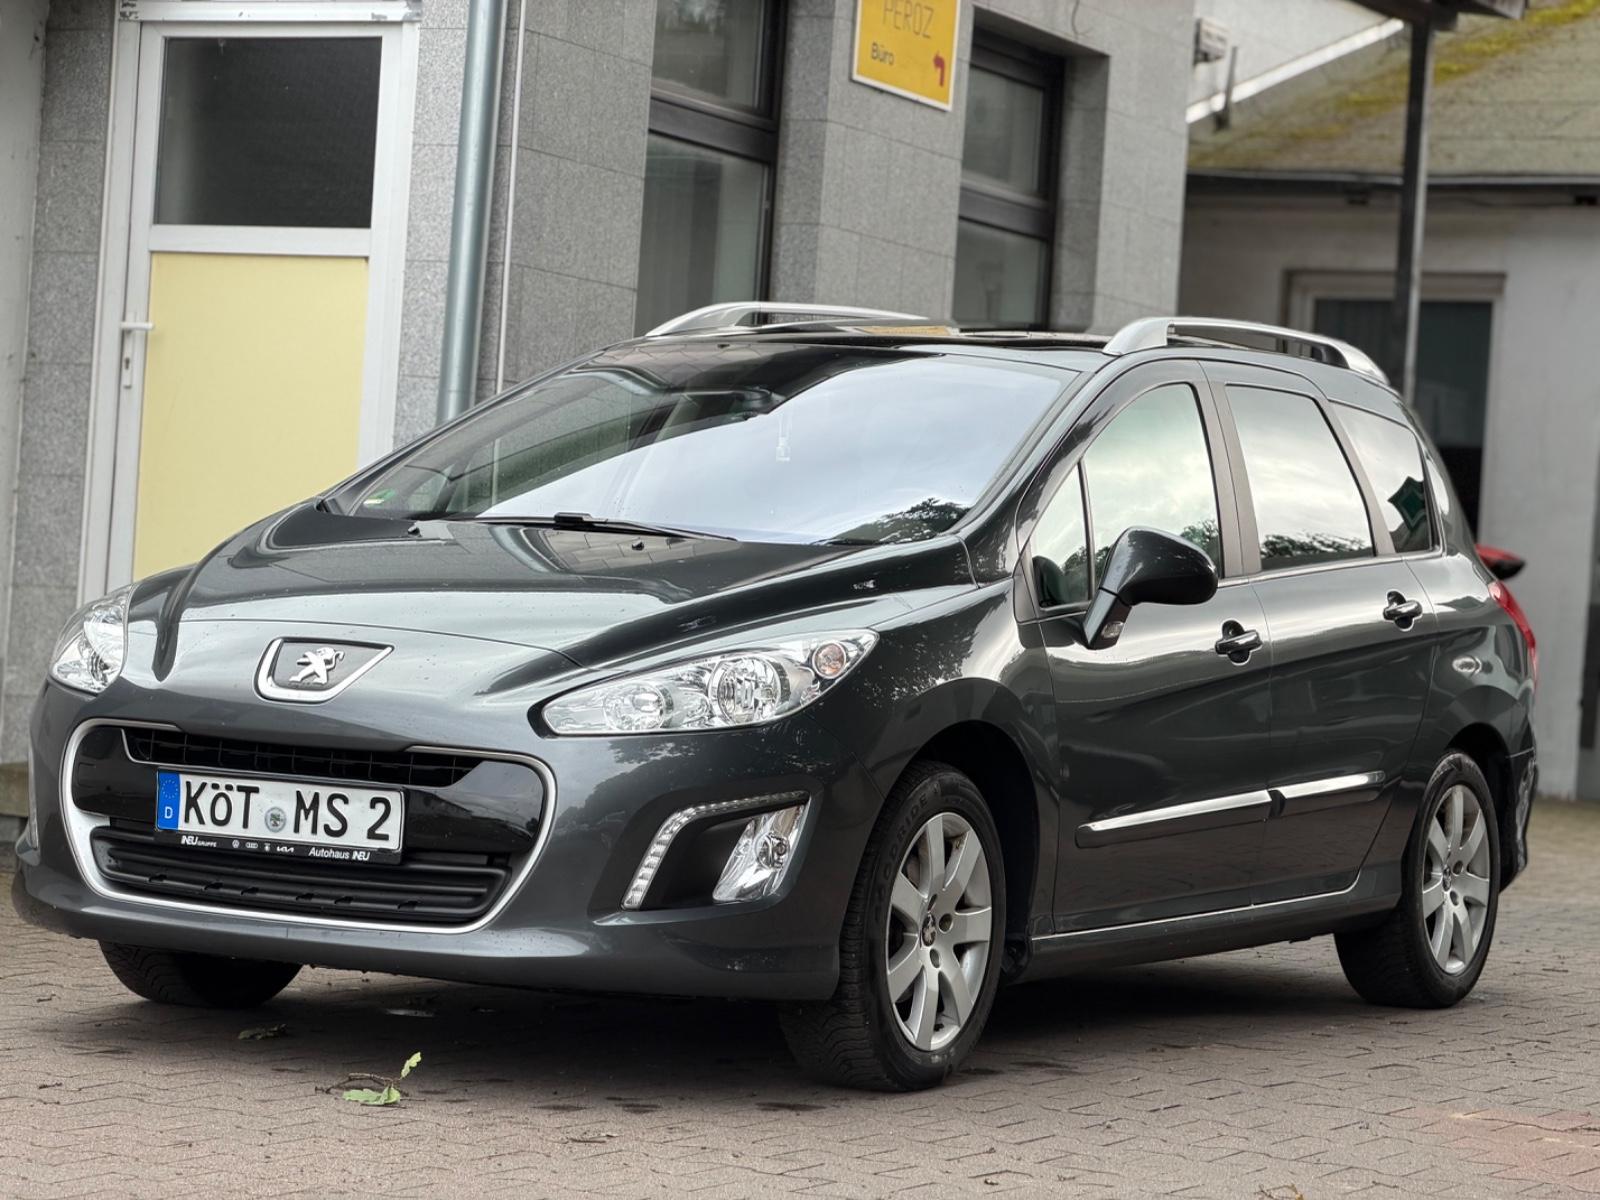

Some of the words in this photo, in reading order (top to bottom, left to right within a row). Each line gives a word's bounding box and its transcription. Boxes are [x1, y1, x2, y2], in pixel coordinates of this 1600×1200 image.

[883, 0, 934, 39] PEROZ
[871, 42, 894, 66] Büro
[164, 806, 173, 819] D
[184, 781, 260, 829] KÖT
[293, 790, 349, 838] MS
[366, 796, 392, 841] 2
[308, 847, 350, 860] Autohaus
